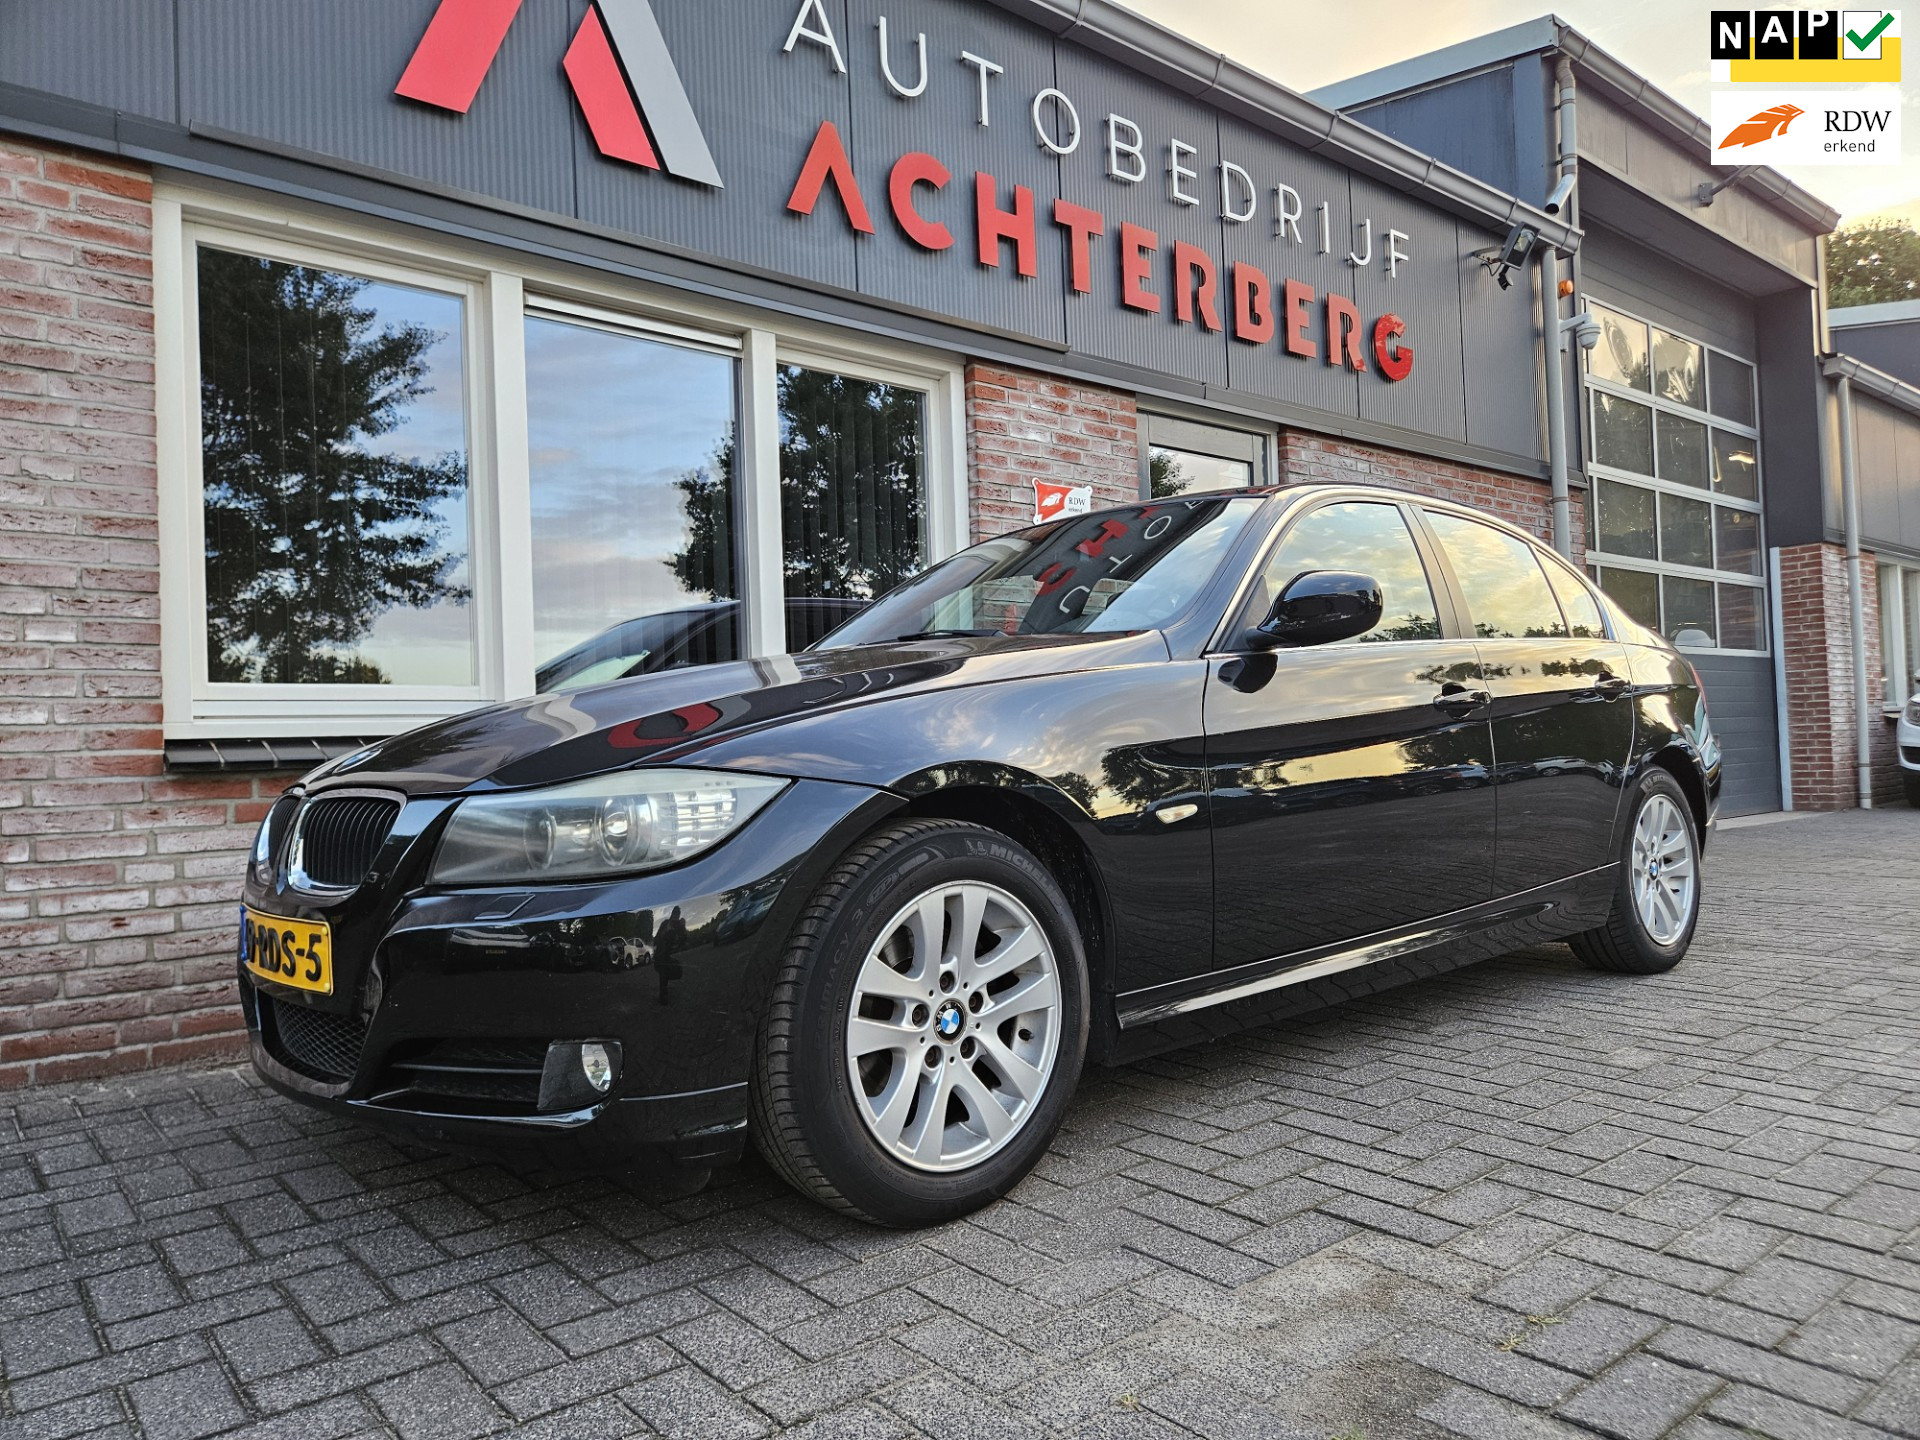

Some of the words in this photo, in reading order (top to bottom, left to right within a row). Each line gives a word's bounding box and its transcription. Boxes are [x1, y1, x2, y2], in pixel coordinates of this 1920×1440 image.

[783, 0, 1410, 278] AUTOBEDRIJF
[787, 120, 1415, 382] ACHTERBERG
[1068, 496, 1086, 507] RDW
